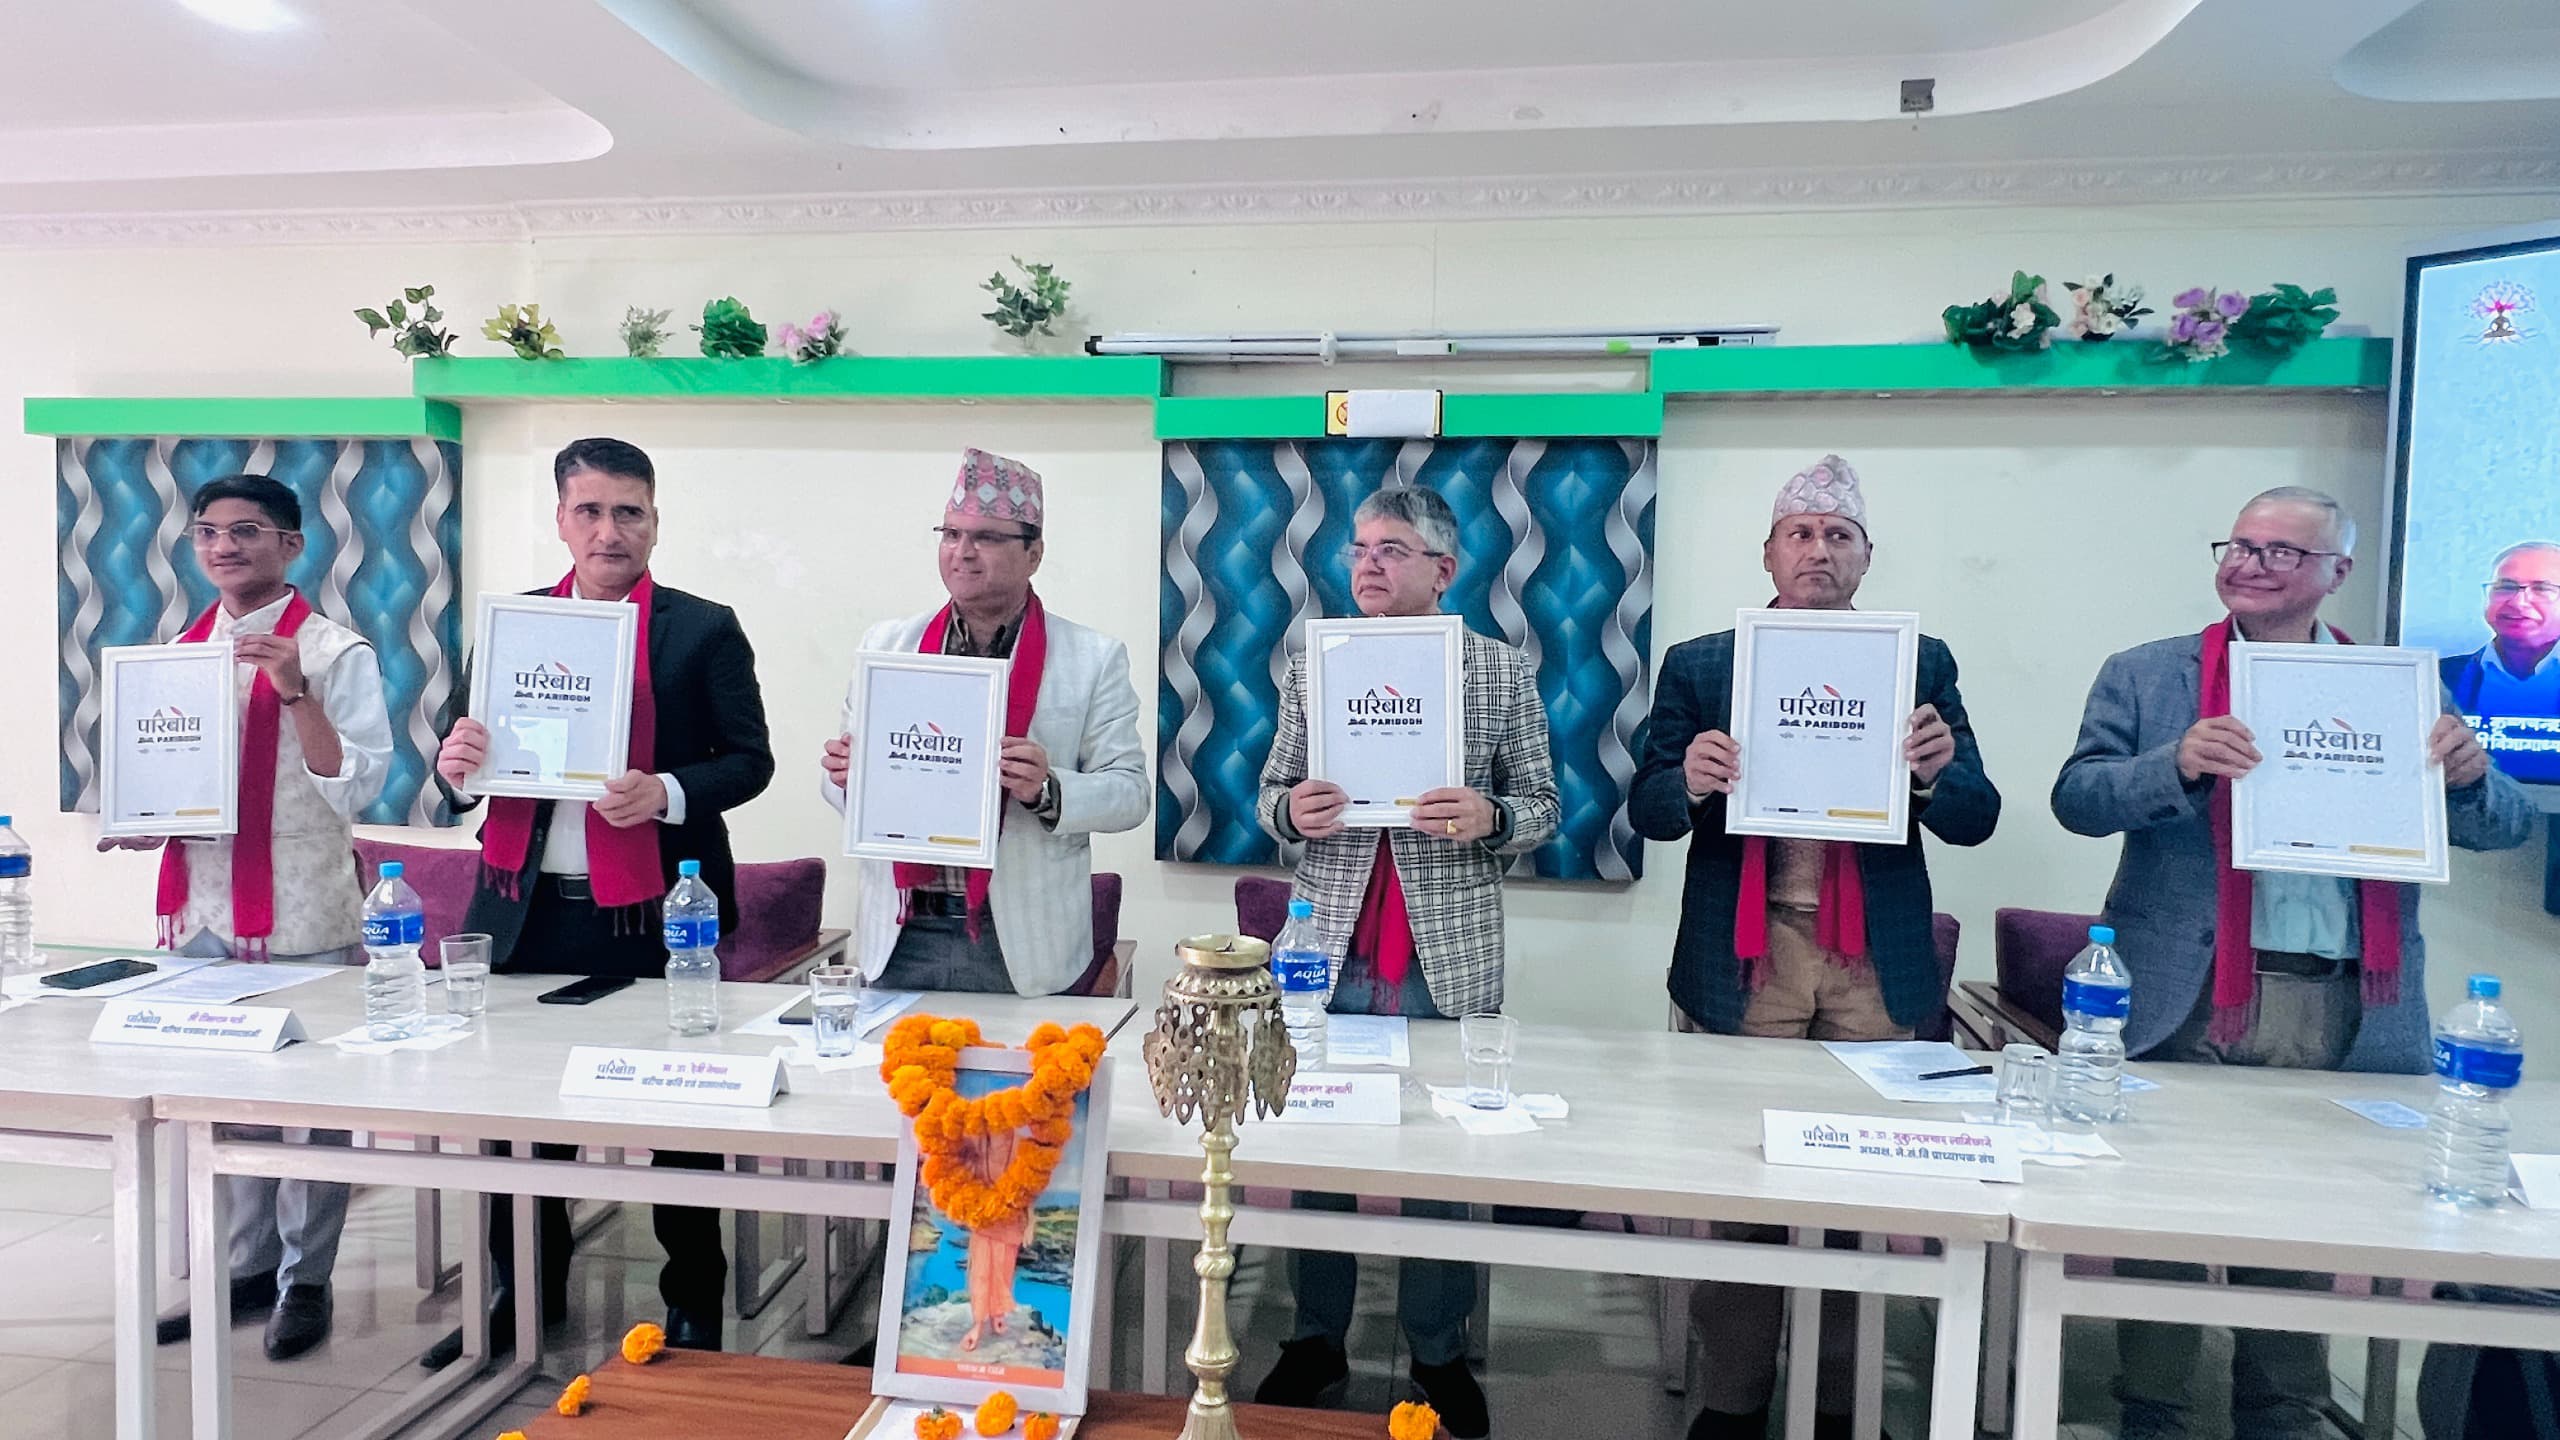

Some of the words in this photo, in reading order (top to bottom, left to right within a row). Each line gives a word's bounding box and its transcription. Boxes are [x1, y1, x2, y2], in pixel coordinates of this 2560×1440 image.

[514, 661, 591, 691] परिबोध
[1347, 685, 1422, 714] परिबोध
[1778, 684, 1866, 717] परिबोध
[136, 706, 201, 734] परिबोध
[1804, 720, 1865, 730] PARIBODH
[2283, 717, 2383, 751] परिबोध
[889, 721, 964, 753] परिबोध
[362, 926, 389, 935] QUA
[1293, 968, 1326, 979] AQUA
